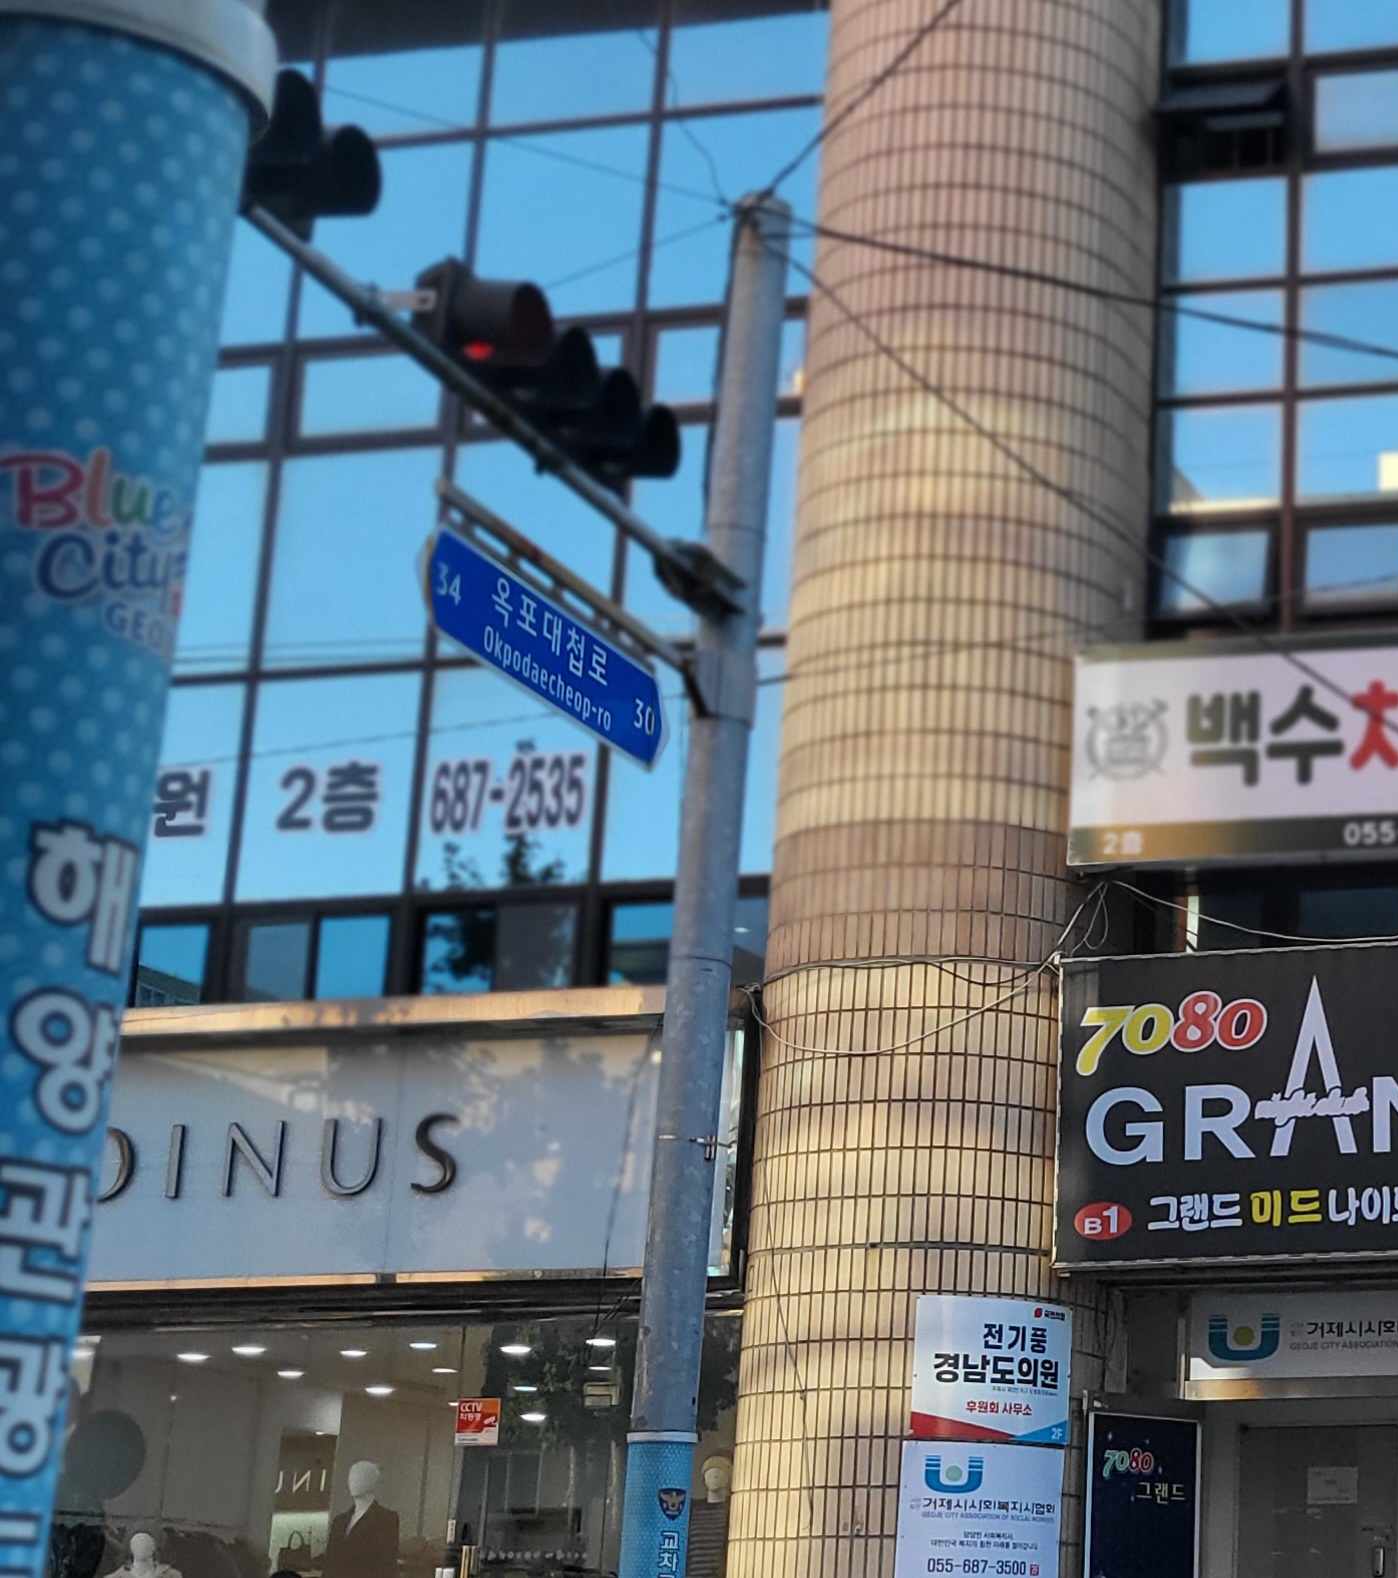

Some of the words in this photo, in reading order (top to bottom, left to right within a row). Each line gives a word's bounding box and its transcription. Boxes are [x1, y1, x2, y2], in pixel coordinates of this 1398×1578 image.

[0, 448, 176, 536] Blue
[436, 560, 462, 607] 34
[491, 576, 609, 687] 옥포대첩로
[483, 625, 612, 733] Okpodaecheop-ro
[633, 698, 656, 736] 30
[276, 760, 380, 834] 2층
[430, 753, 588, 835] 687-2535
[1102, 831, 1144, 855] 2층
[1075, 990, 1268, 1077] 7080
[1083, 1206, 1120, 1236] B1
[1147, 1192, 1243, 1232] 그랜드
[1250, 1188, 1323, 1226] 미드
[983, 1323, 1048, 1354] 전기풍
[933, 1352, 1060, 1390] 경남도의원
[460, 1402, 483, 1412] CCTV
[966, 1400, 1000, 1414] 후원회
[1002, 1401, 1033, 1416] 사무소
[1102, 1448, 1154, 1478] 7080
[1136, 1481, 1187, 1505] 그랜드
[658, 1530, 680, 1578] 교차
[927, 1557, 1027, 1576] 055-687-3500
